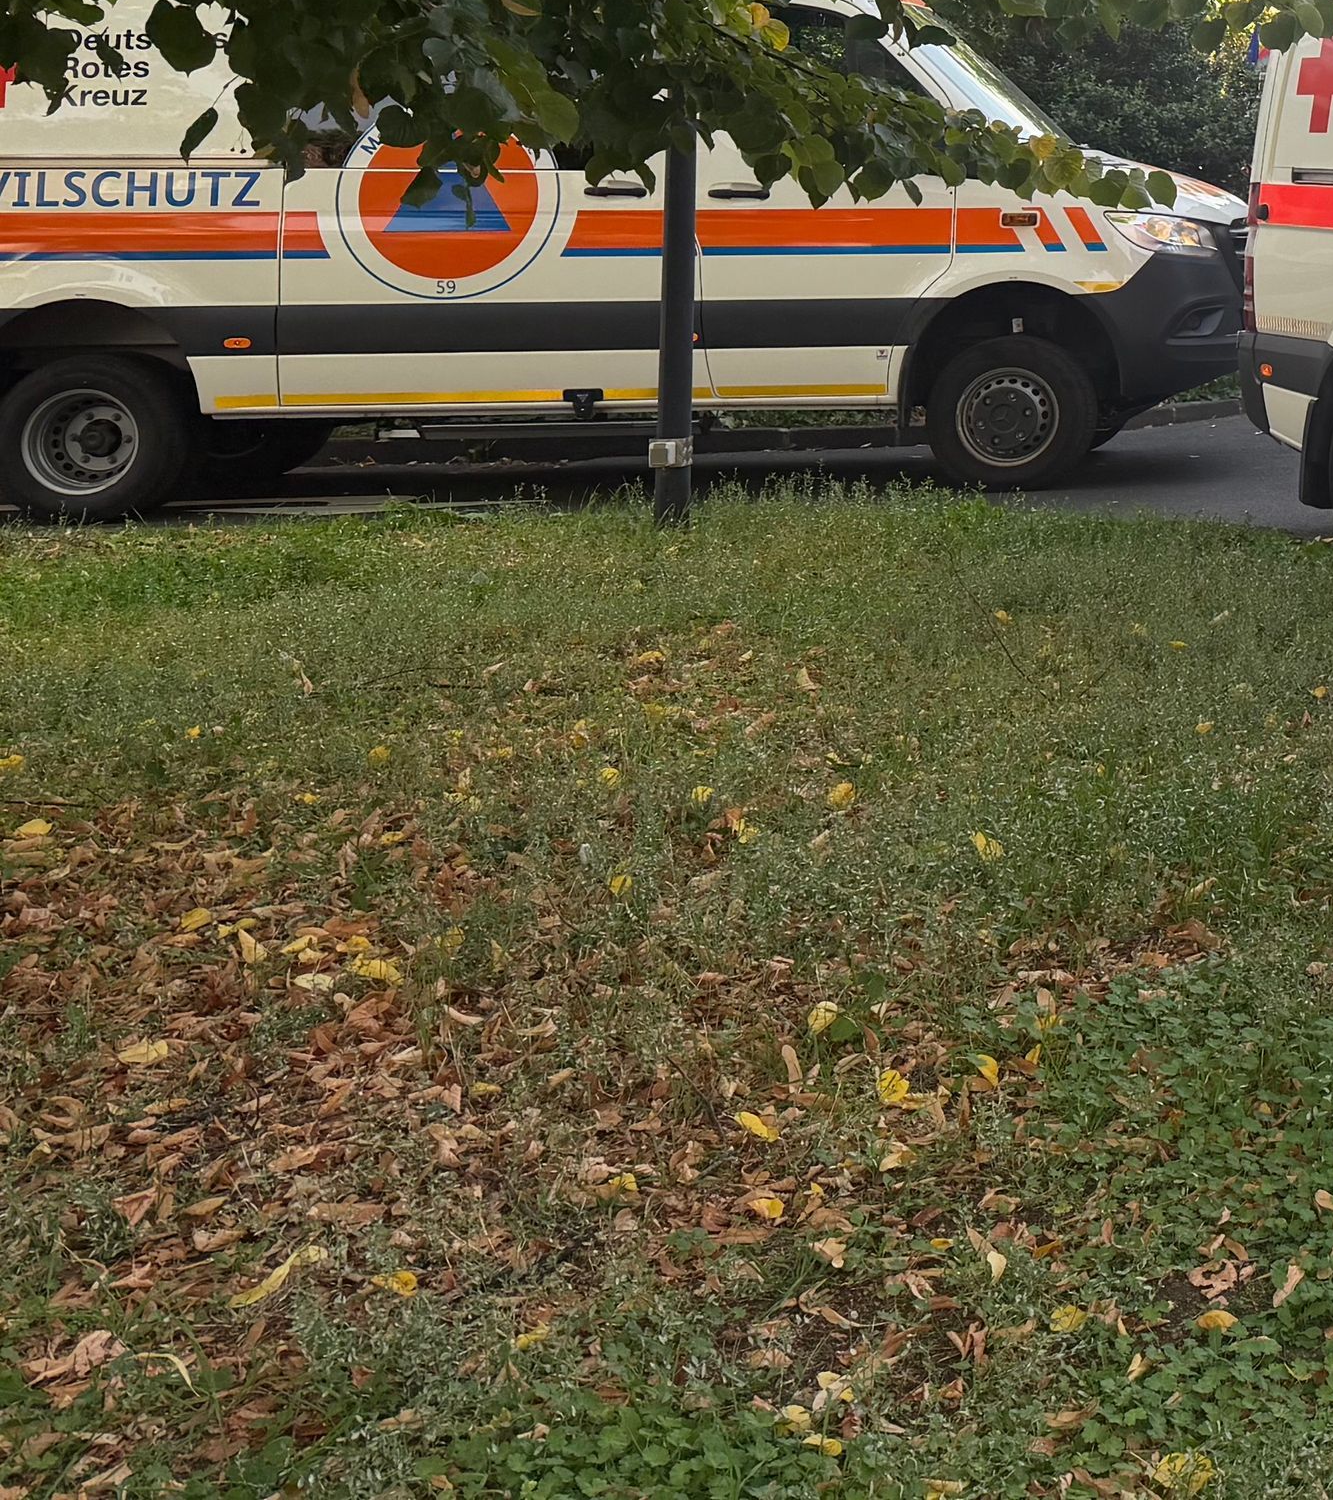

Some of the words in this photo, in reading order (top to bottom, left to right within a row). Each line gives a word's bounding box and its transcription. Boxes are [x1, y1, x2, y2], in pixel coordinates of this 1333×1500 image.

[72, 29, 228, 51] Deutss
[66, 56, 150, 79] Rotes
[59, 84, 149, 107] Kreuz
[435, 280, 457, 295] 59
